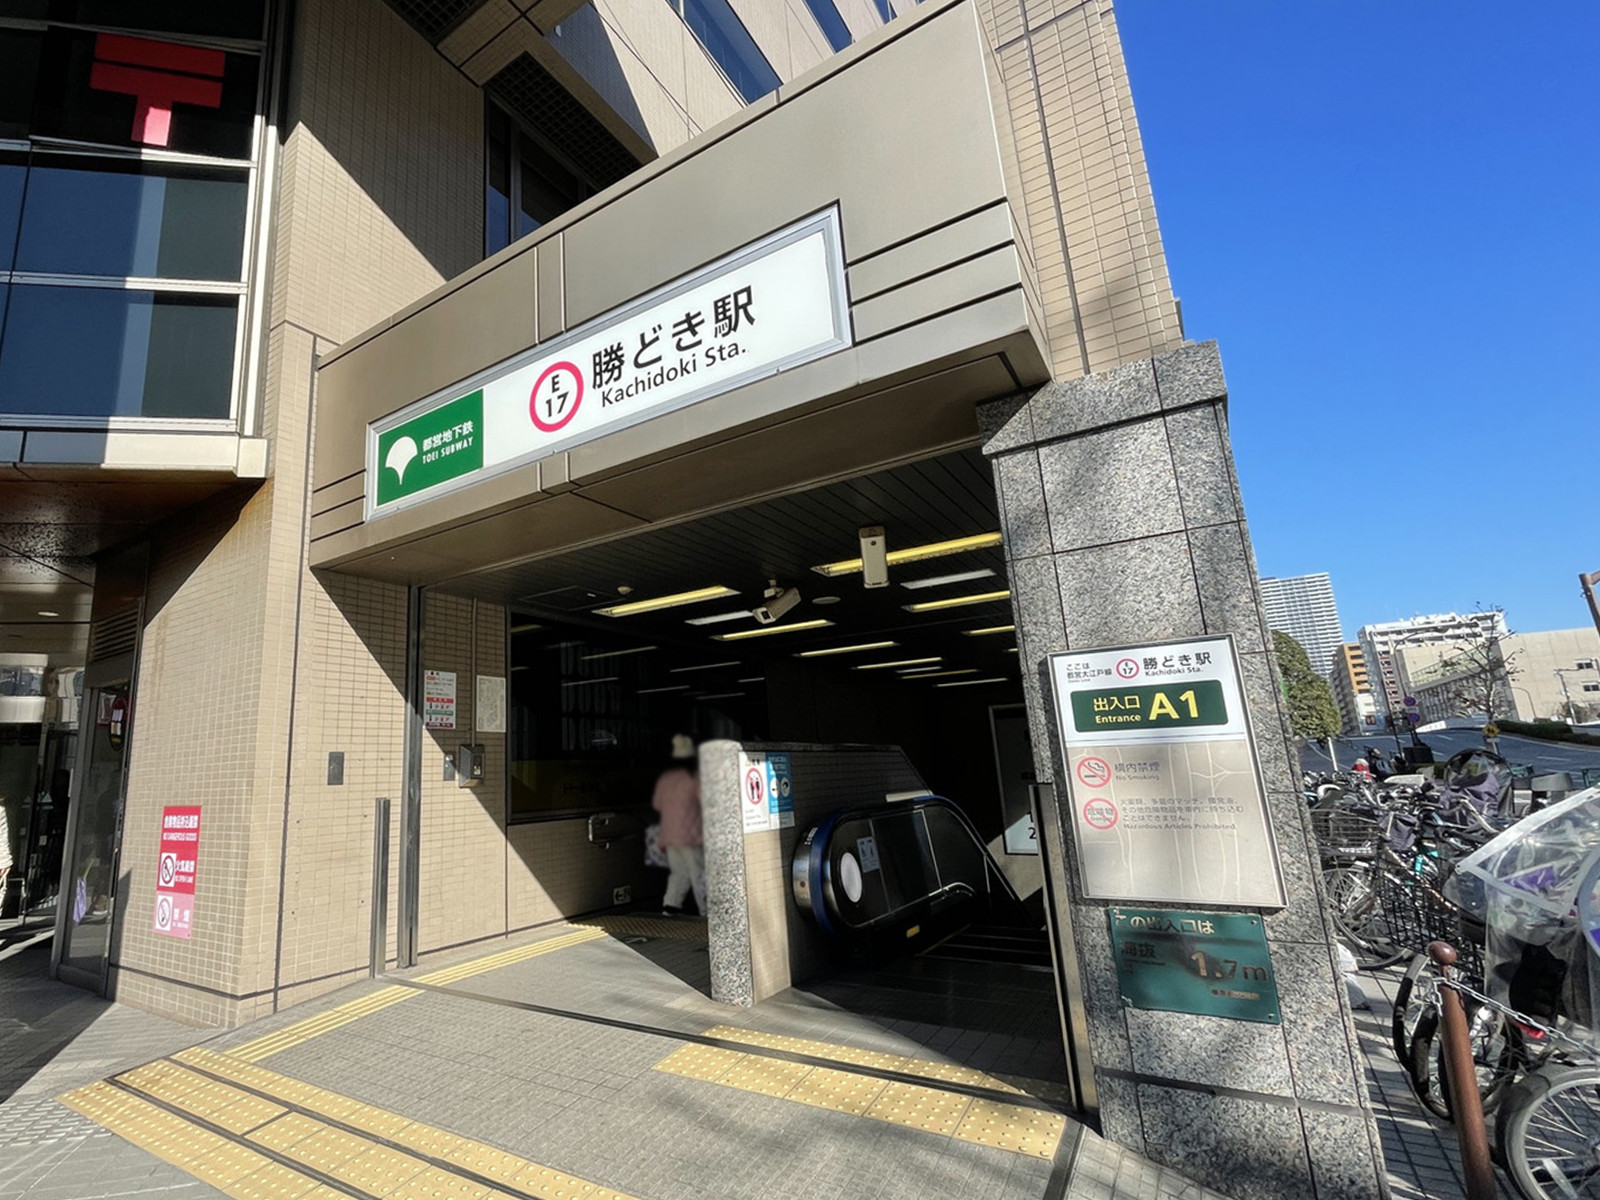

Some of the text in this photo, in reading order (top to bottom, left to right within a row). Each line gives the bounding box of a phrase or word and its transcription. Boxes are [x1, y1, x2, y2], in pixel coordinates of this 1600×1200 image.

[592, 285, 756, 390] 勝どき駅
[551, 374, 560, 393] E
[602, 341, 747, 408] Kachidoki Sta.
[545, 391, 569, 418] 17
[422, 420, 474, 452] 都営地下鉄
[422, 436, 474, 465] TOEI SUBWAY
[1066, 662, 1090, 671] ここは
[1143, 652, 1212, 670] 勝どき駅
[1067, 668, 1113, 679] 都営大江戸線
[1122, 667, 1134, 676] 17
[1145, 666, 1204, 677] Kachidoki Sta.
[1093, 690, 1199, 721] 出入口 A1
[1095, 714, 1141, 724] Entrance
